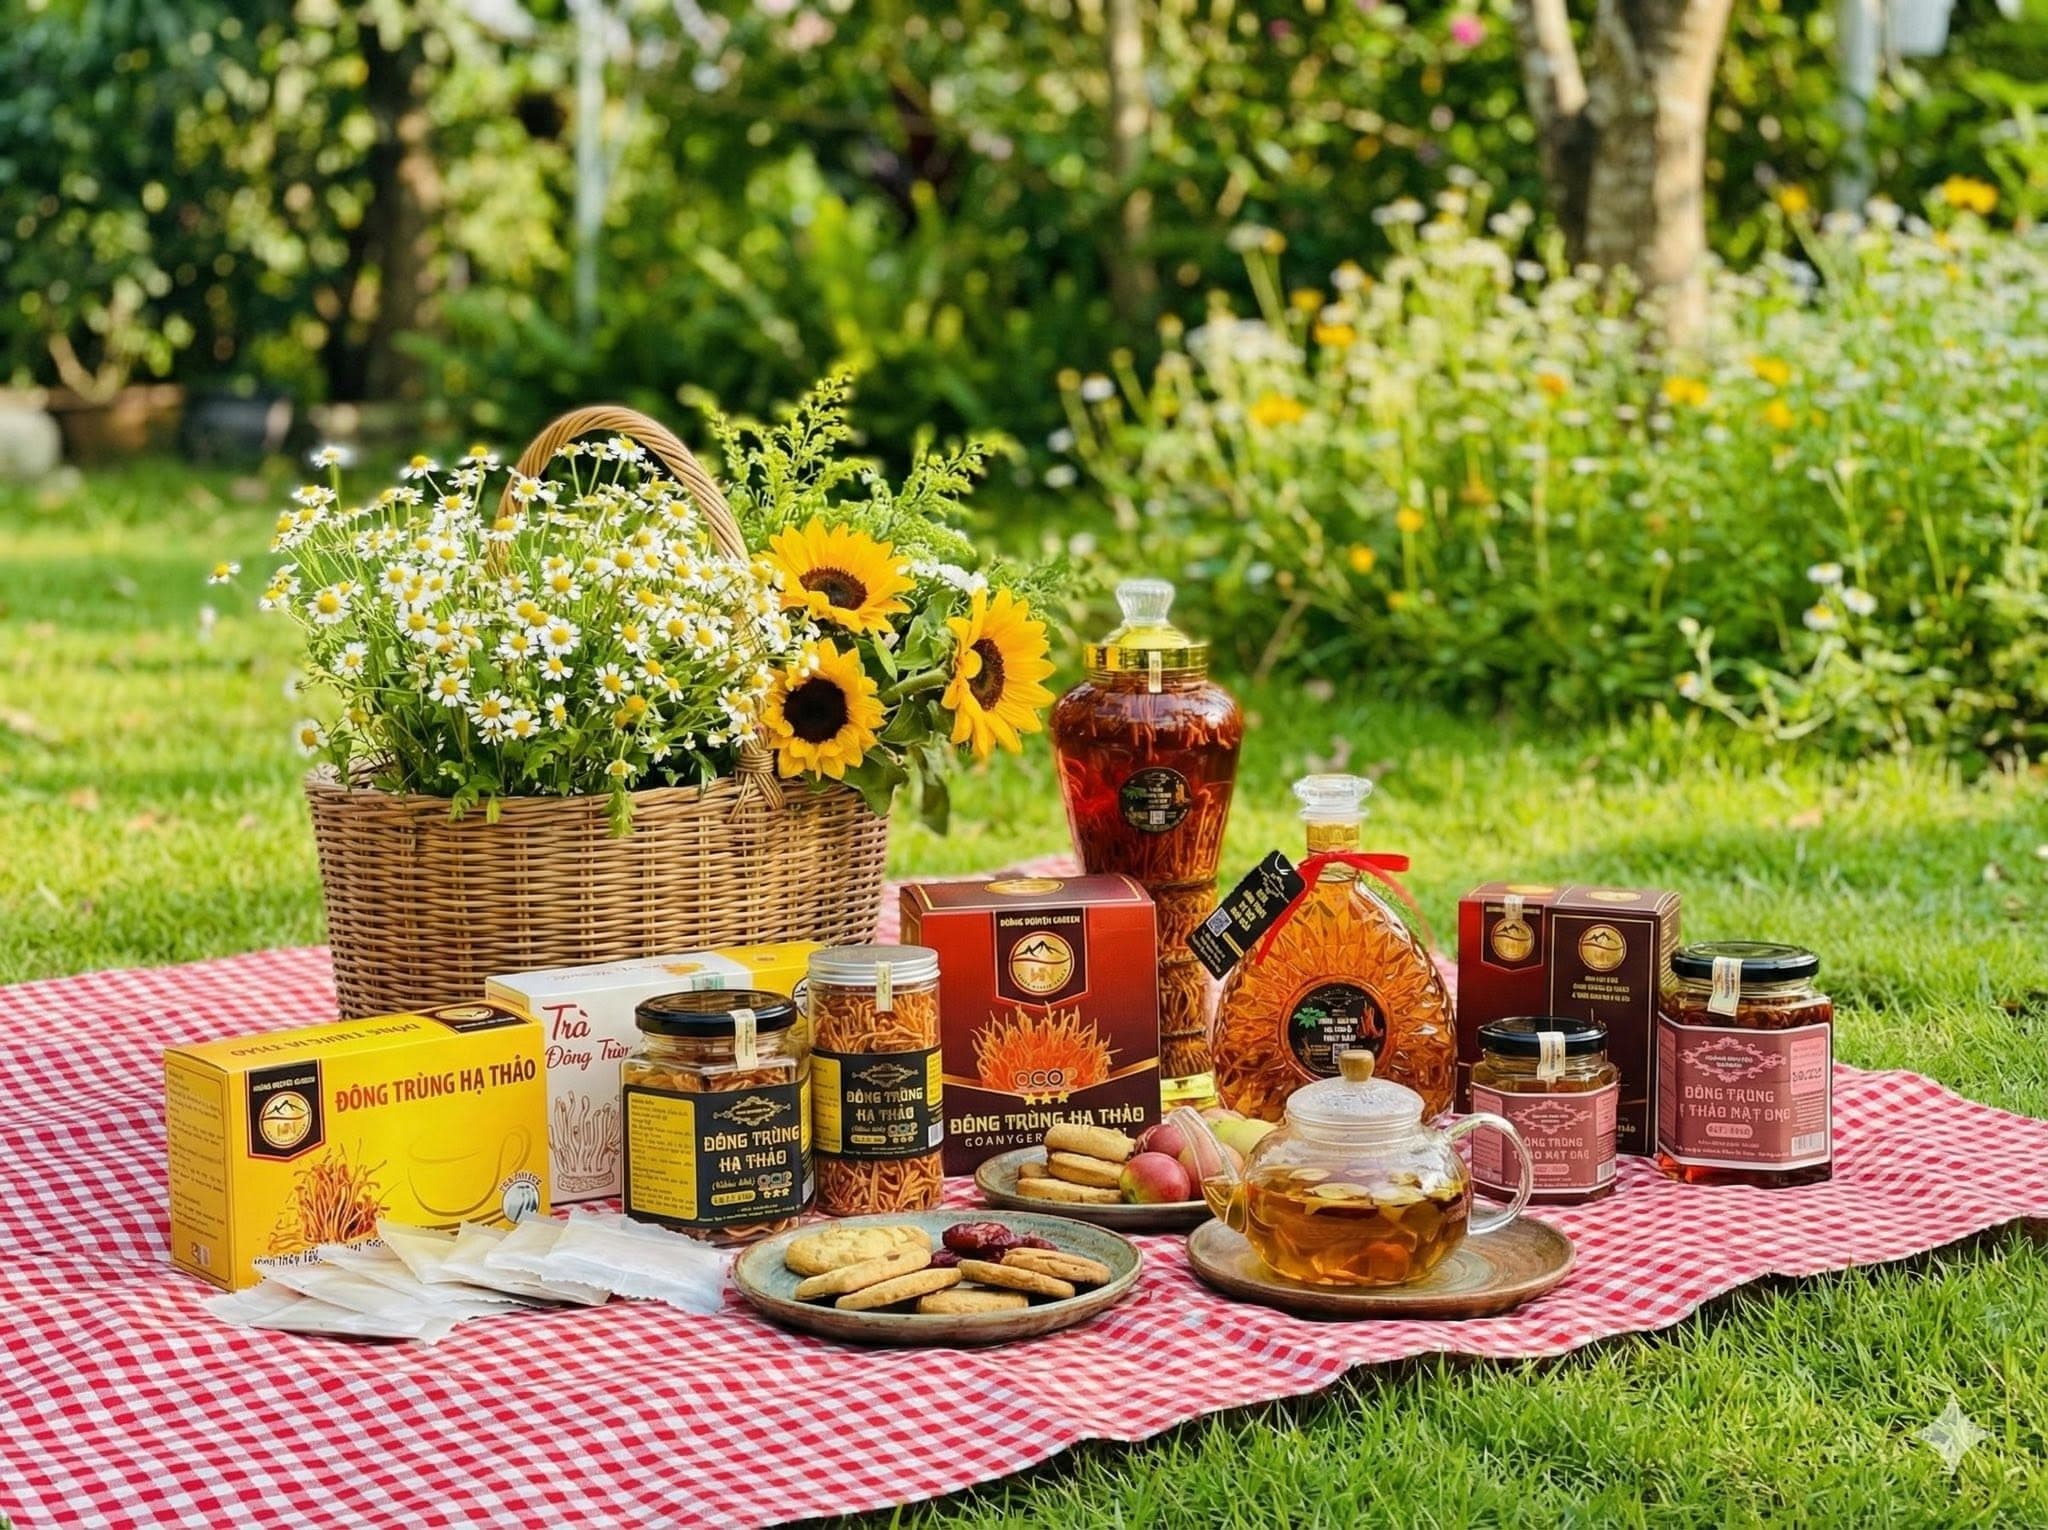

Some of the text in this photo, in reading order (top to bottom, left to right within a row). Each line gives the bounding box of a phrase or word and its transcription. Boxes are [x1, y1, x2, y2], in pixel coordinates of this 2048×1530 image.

[542, 1004, 591, 1041] Trà
[545, 1038, 633, 1071] Đông Trùn
[335, 1083, 388, 1113] ĐÔNG
[392, 1072, 455, 1103] TRÙNG
[460, 1067, 485, 1095] HẠ
[488, 1054, 536, 1087] THẢO
[1014, 1066, 1078, 1089] OCOP
[949, 1113, 1000, 1135] ĐÔNG
[1004, 1109, 1064, 1131] TRÙNG
[1098, 1103, 1145, 1125] THẢO
[752, 1126, 800, 1146] TRÙNG
[718, 1146, 787, 1175] HẠ THẢO
